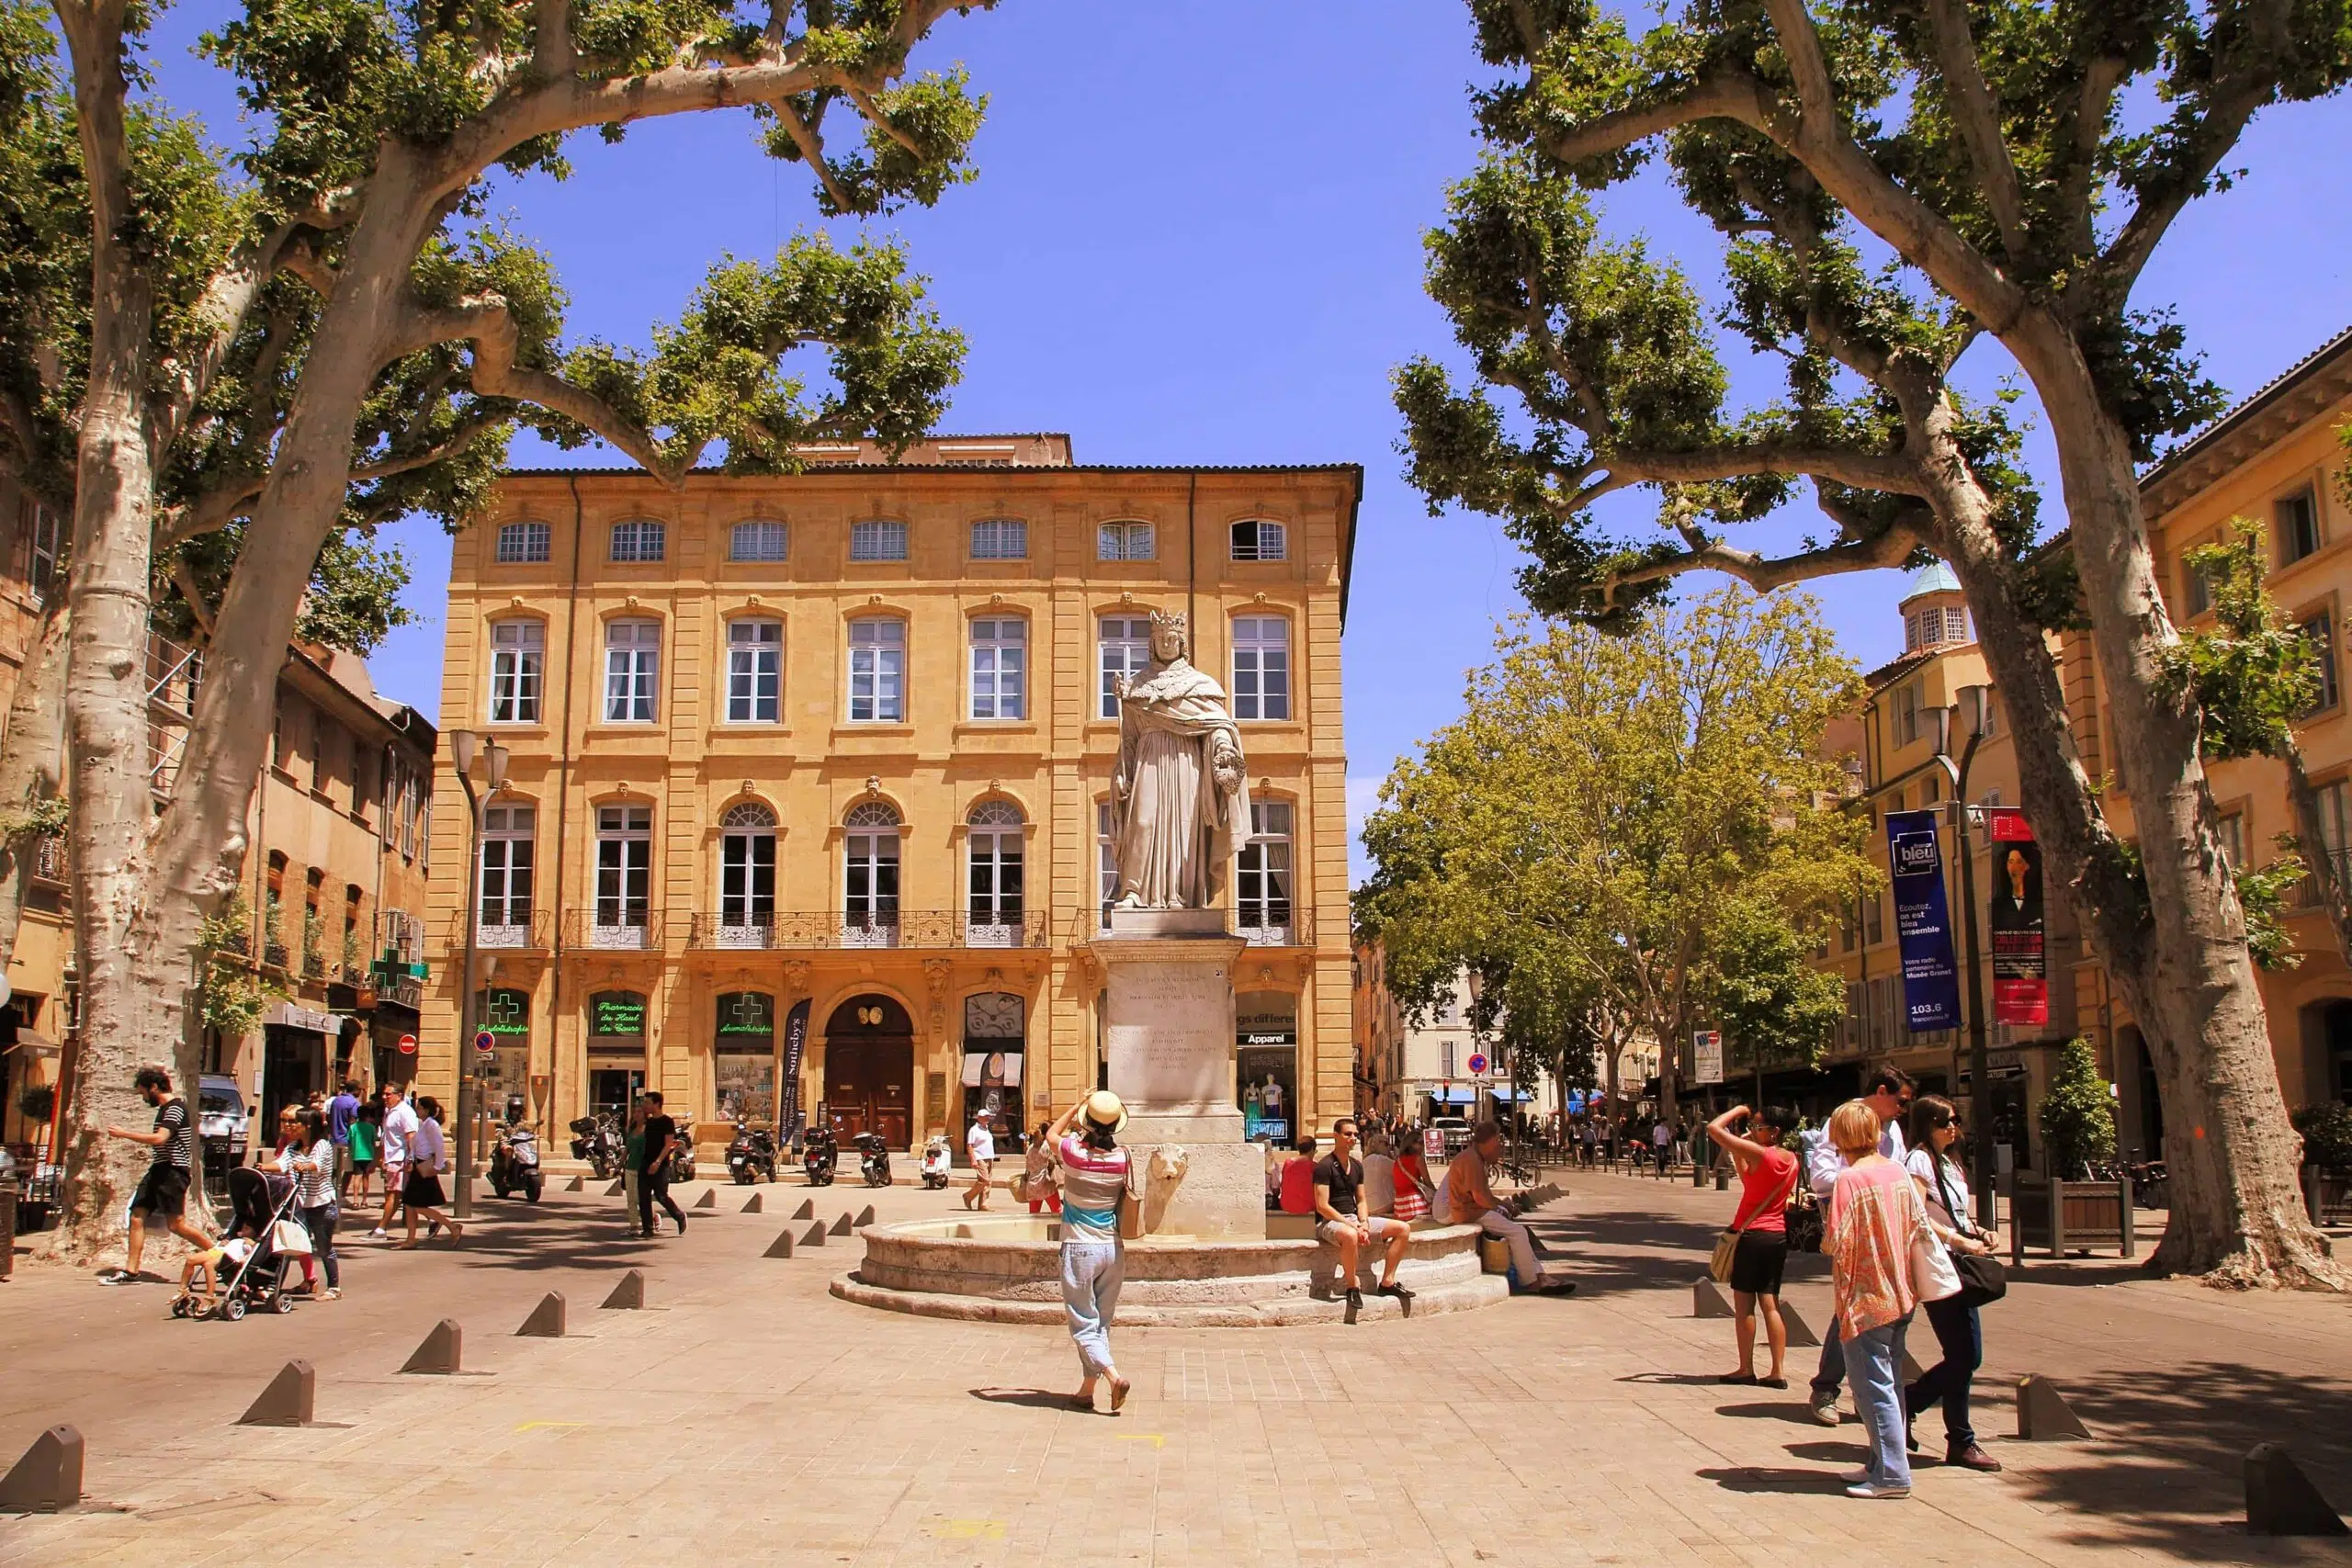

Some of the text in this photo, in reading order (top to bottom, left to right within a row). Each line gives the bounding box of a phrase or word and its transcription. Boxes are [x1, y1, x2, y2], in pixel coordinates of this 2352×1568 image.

[1901, 846, 1934, 861] bleu
[1900, 912, 1910, 920] on
[1901, 919, 1918, 928] bien
[1902, 926, 1940, 936] ensemble
[1906, 971, 1928, 979] Musée
[598, 1001, 643, 1011] Pharmacie
[1911, 1003, 1942, 1015] 103.6
[599, 1024, 612, 1032] du
[1248, 1034, 1284, 1044] Apparel
[788, 1018, 802, 1076] Sotheby's
